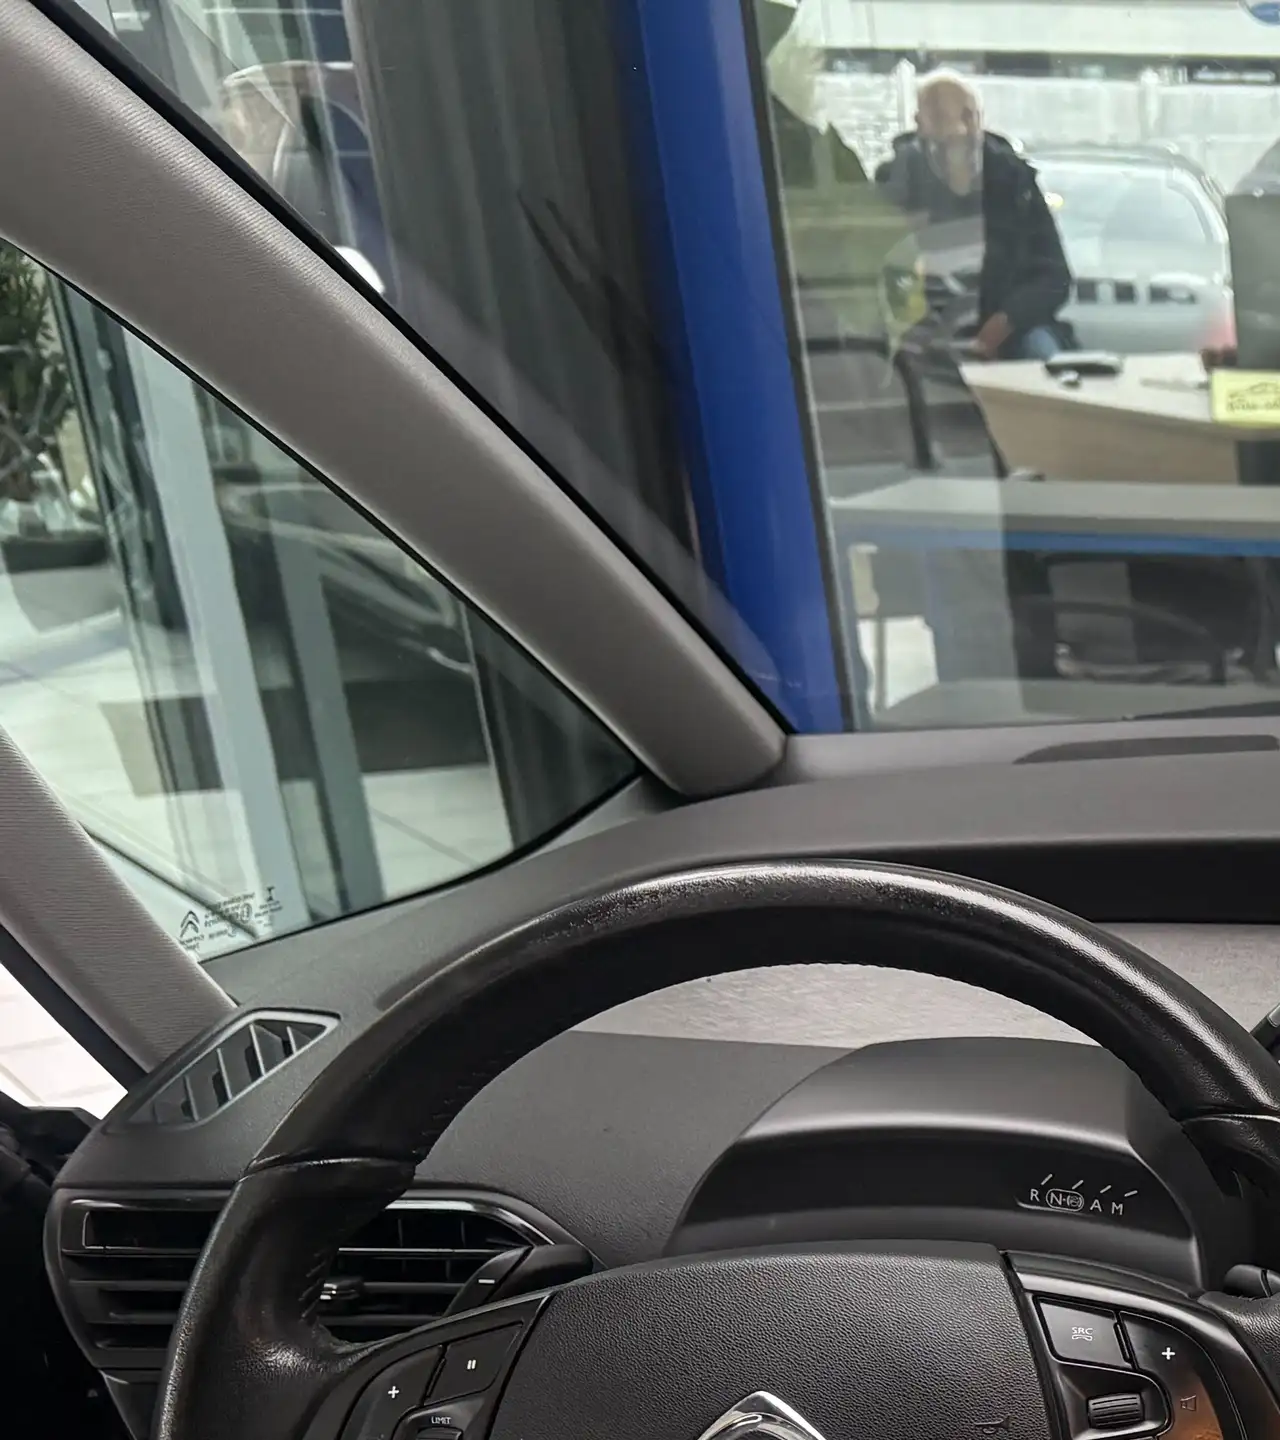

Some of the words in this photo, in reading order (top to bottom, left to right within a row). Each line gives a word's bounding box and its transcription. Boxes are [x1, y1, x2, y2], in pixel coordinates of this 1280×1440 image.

[1030, 1188, 1040, 1202] R
[1050, 1192, 1062, 1206] N
[1090, 1199, 1102, 1212] A
[1111, 1202, 1123, 1215] M
[1071, 1326, 1093, 1335] SRC
[431, 1416, 452, 1424] LIMIT
